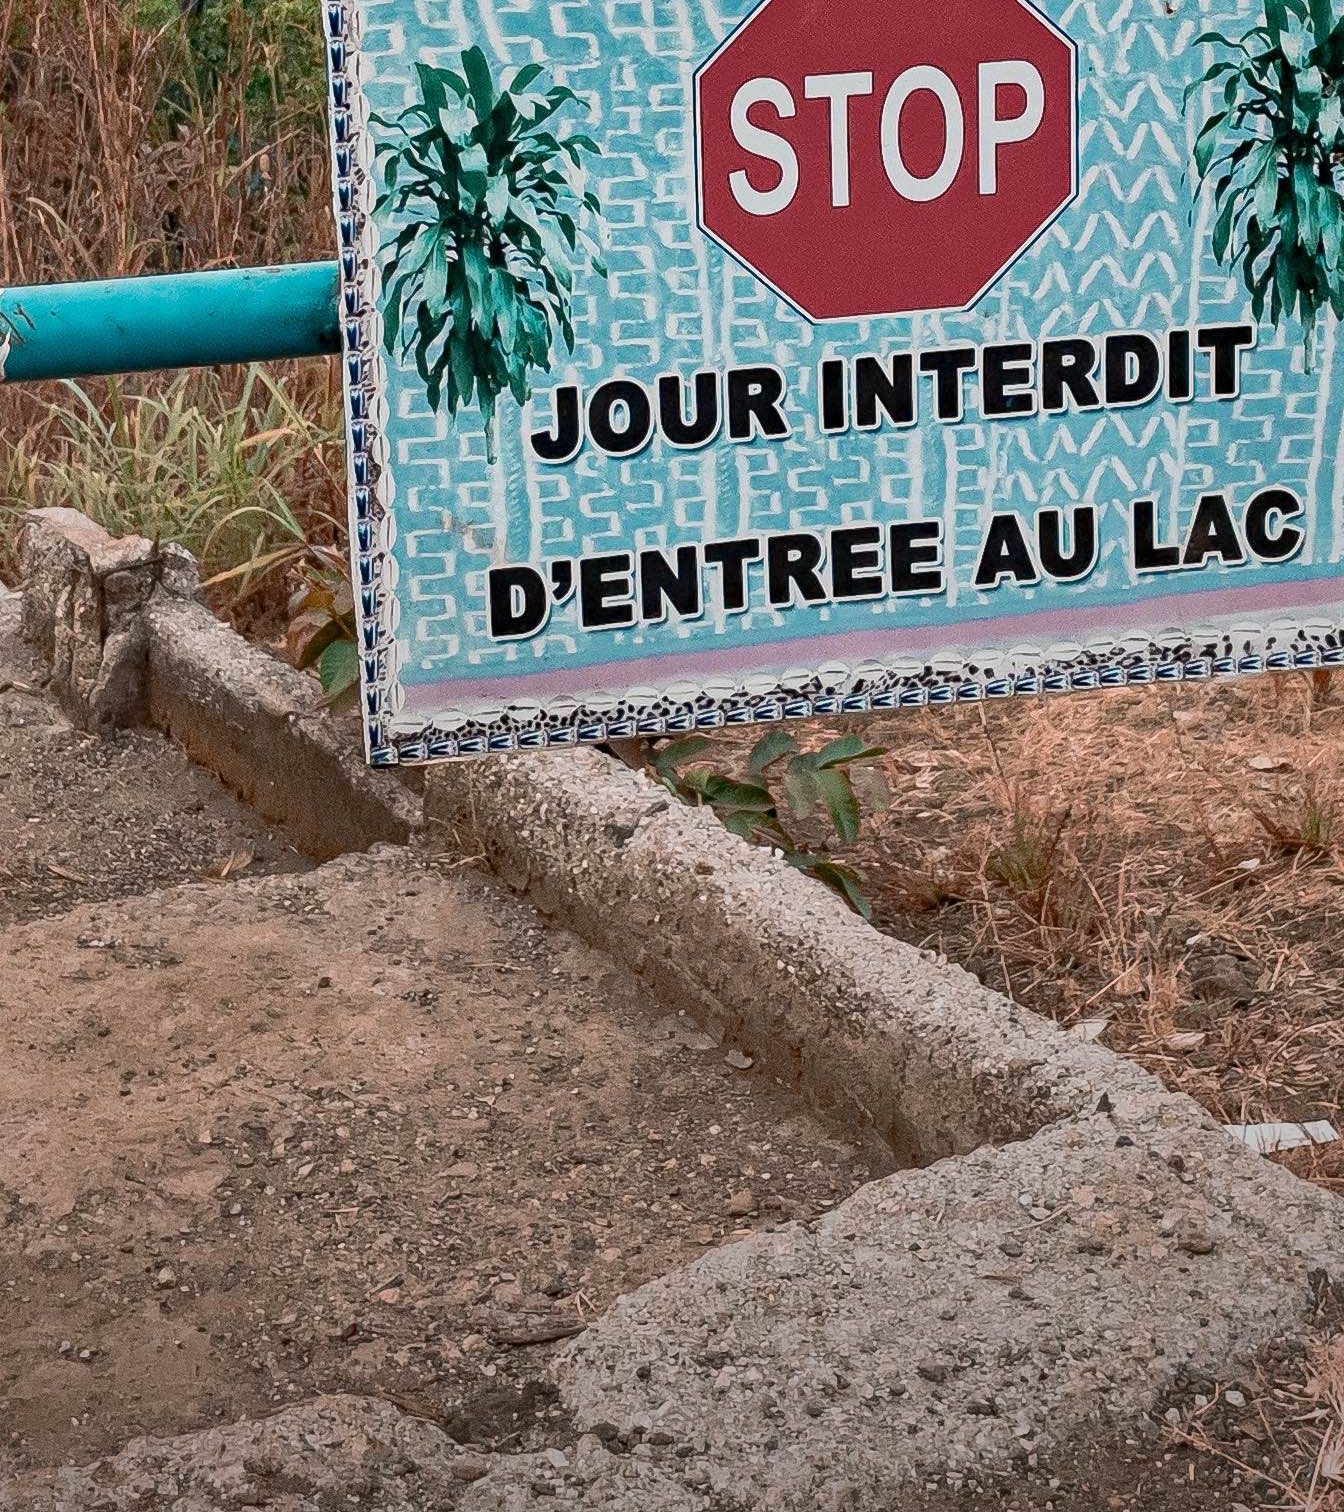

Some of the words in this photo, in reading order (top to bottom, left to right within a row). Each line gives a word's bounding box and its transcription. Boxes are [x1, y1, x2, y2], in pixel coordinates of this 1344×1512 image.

[728, 59, 1045, 218] STOP
[531, 365, 787, 464] JOUR
[821, 326, 1254, 433] INTERDIT
[488, 520, 944, 638] D’ENTREE
[975, 505, 1095, 587] AU
[1133, 488, 1304, 570] LAC
